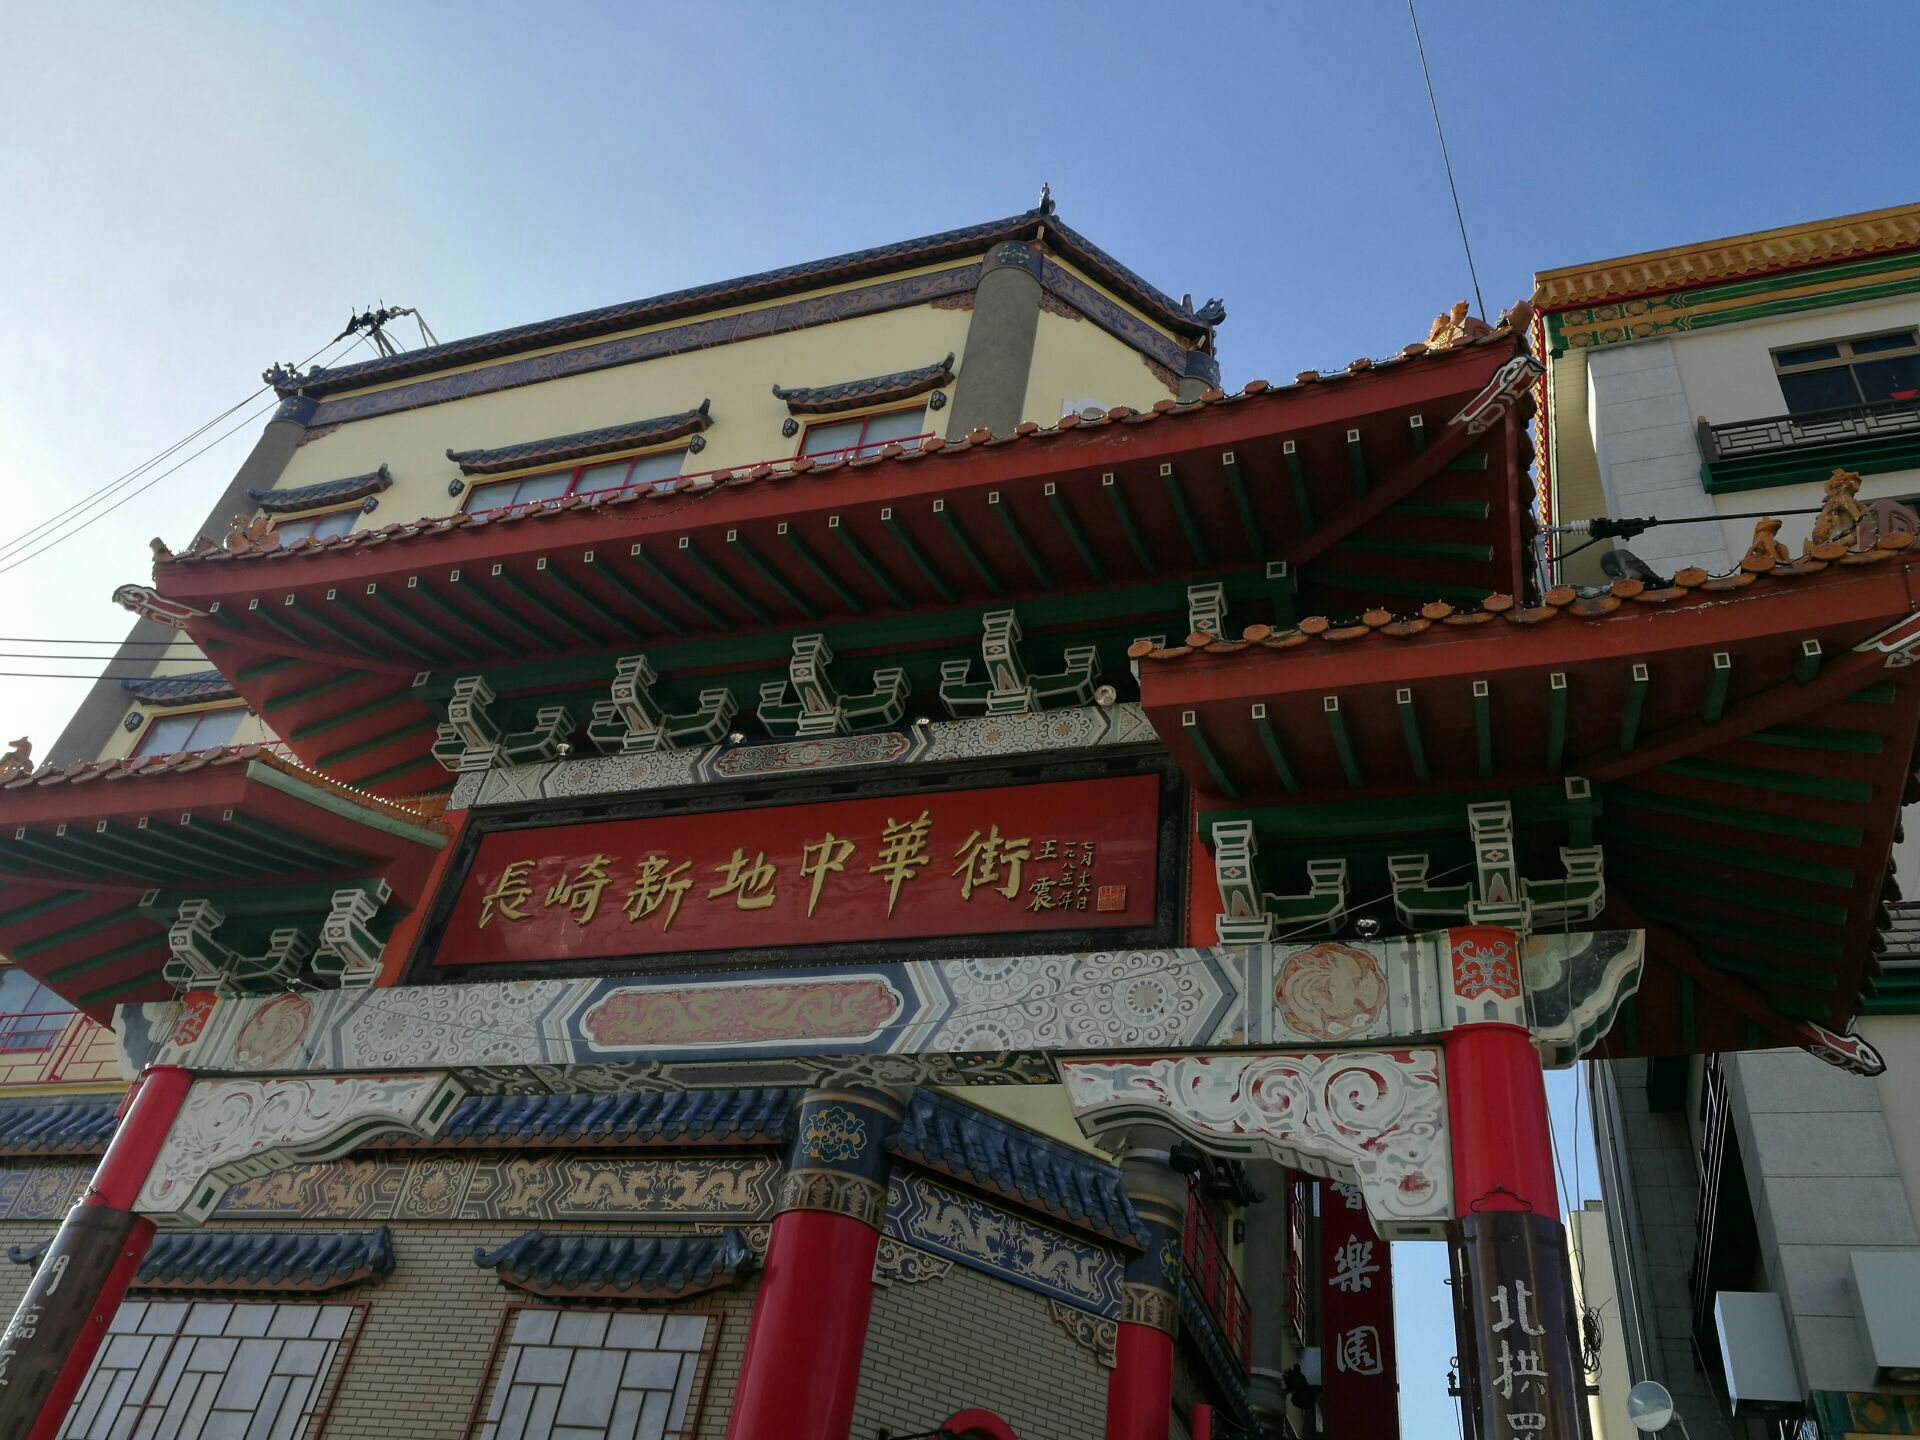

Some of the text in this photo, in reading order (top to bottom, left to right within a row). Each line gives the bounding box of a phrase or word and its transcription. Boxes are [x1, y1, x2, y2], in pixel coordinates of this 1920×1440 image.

[479, 810, 1031, 932] 長崎新地中華街
[1026, 839, 1058, 912] 王震
[1058, 841, 1077, 910] 一九八五年
[1076, 841, 1094, 910] 七月十六日
